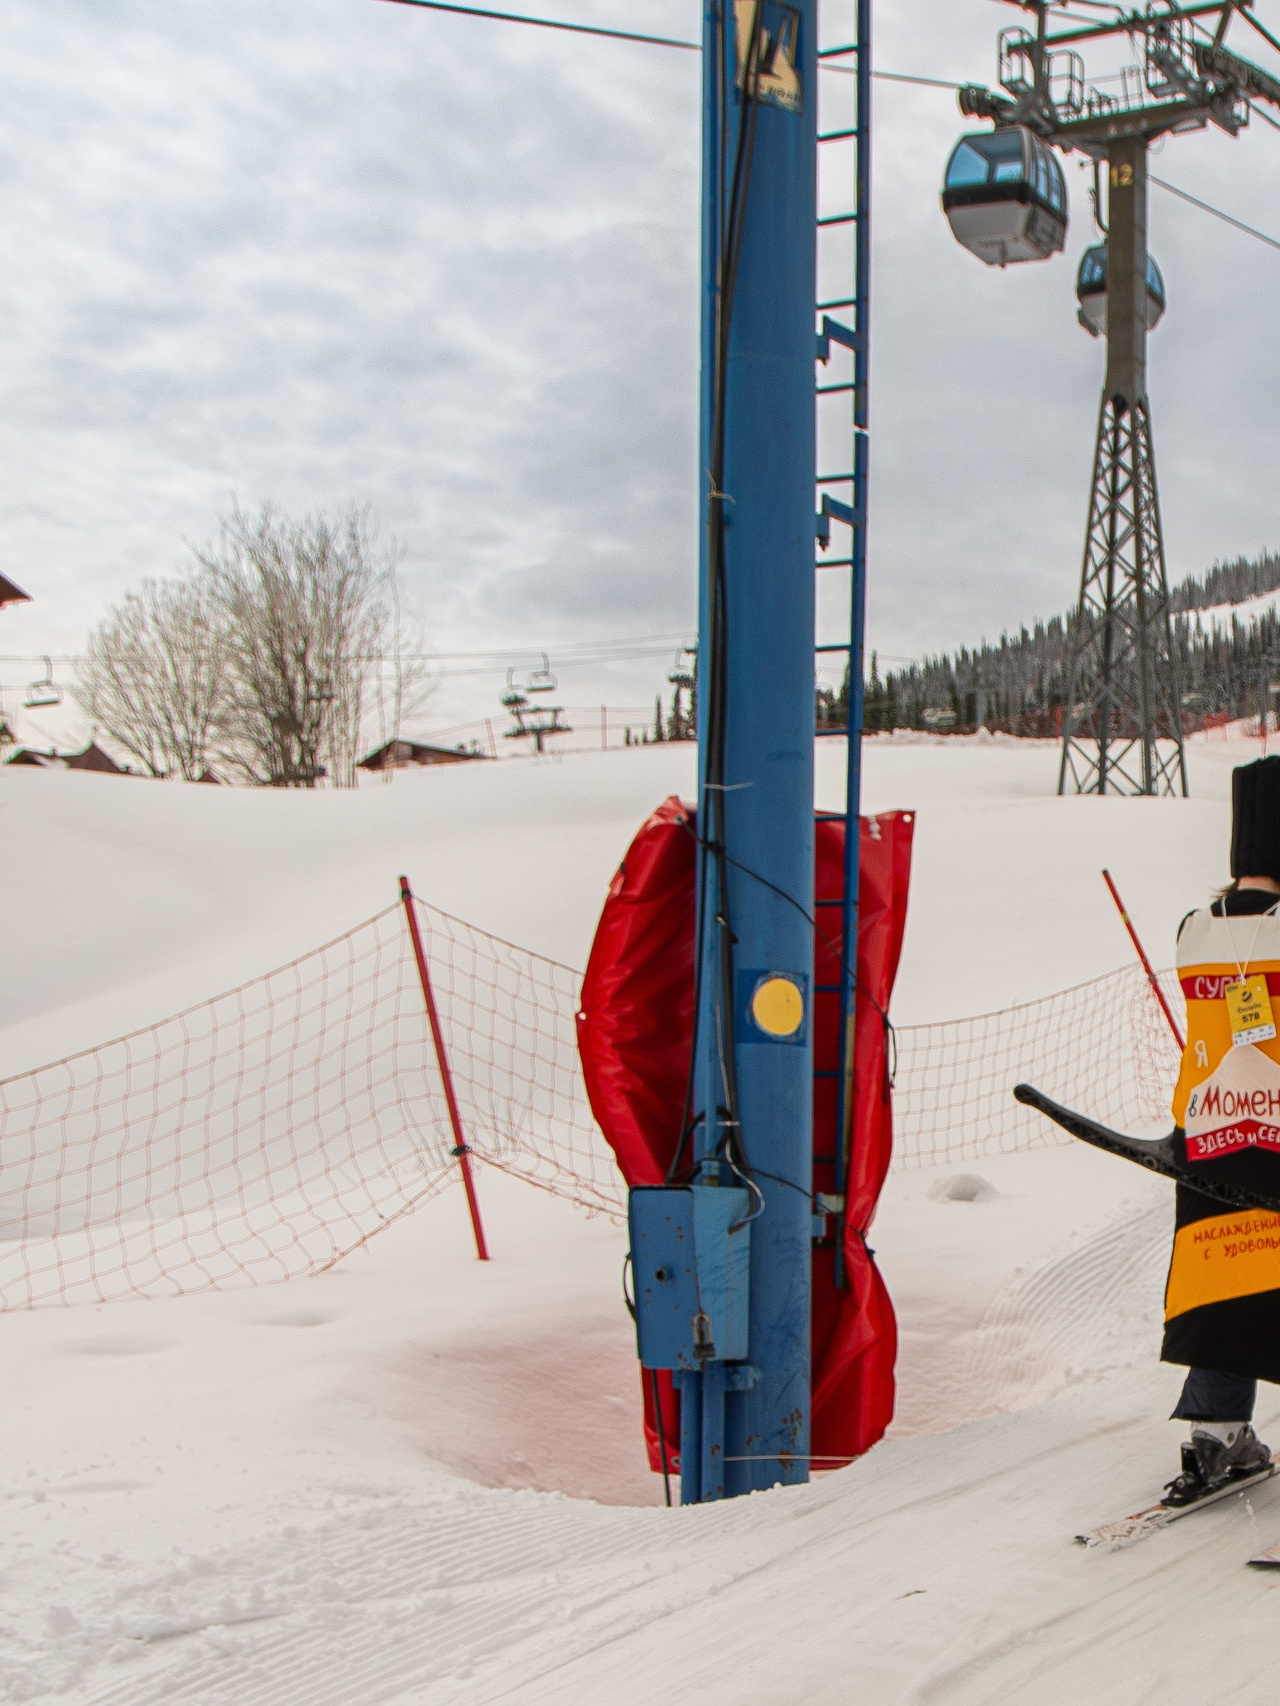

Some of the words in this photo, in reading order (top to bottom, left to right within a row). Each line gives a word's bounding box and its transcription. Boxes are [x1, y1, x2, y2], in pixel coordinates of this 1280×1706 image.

[1110, 163, 1134, 188] 12
[1195, 1040, 1208, 1068] Я
[1196, 1128, 1245, 1154] ЗДЕСЬ
